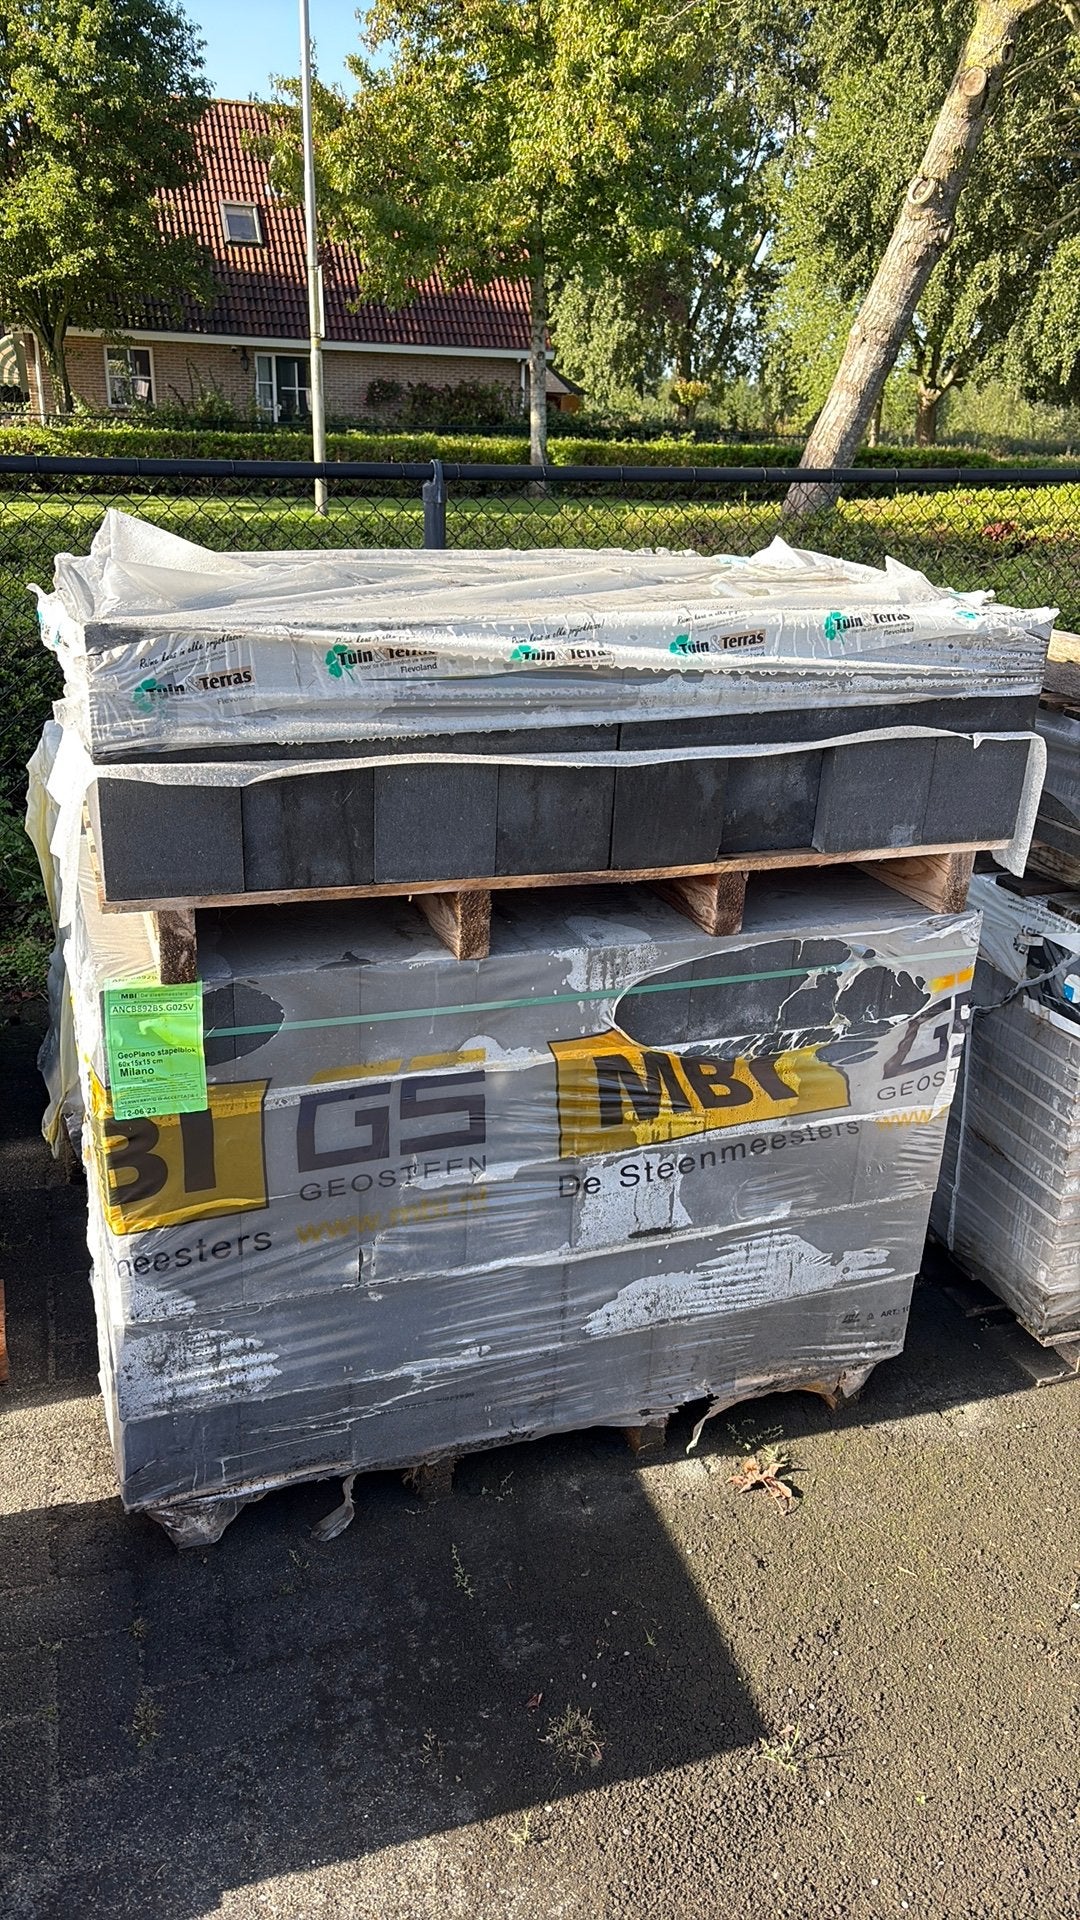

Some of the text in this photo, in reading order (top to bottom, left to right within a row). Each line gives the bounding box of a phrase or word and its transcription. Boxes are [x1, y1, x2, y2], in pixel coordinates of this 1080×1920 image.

[400, 662, 438, 673] Flevoland
[117, 1047, 196, 1060] GeoPlano stapelblok
[118, 1059, 151, 1067] 60x15x15
[120, 1067, 155, 1077] Milano
[593, 1051, 799, 1127] MBI
[296, 1070, 486, 1173] GS
[558, 1120, 860, 1198] De Steenmeesters
